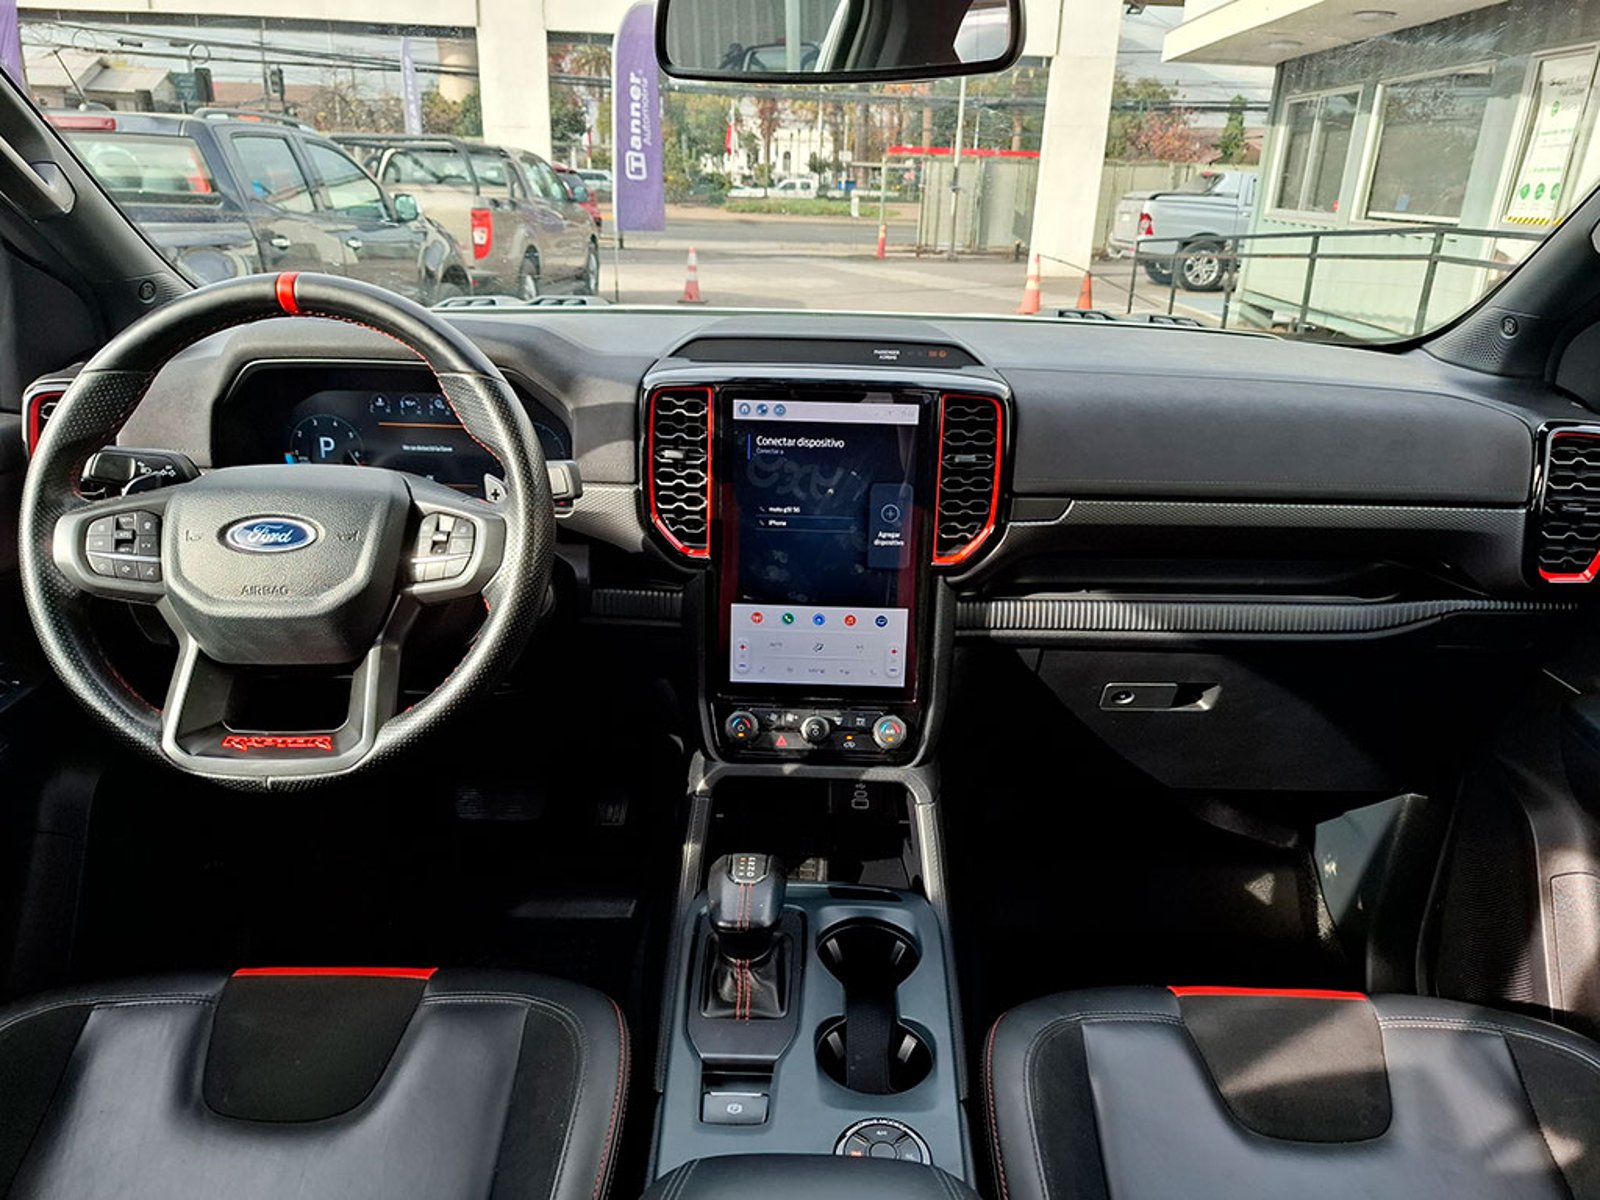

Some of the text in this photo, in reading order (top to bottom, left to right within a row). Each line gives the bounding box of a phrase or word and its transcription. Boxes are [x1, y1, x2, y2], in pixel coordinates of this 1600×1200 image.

[625, 72, 647, 181] Tanner
[319, 436, 336, 459] P
[756, 435, 845, 449] Conectar dispositivo
[247, 525, 293, 544] Ford
[240, 584, 290, 597] AIRBAG
